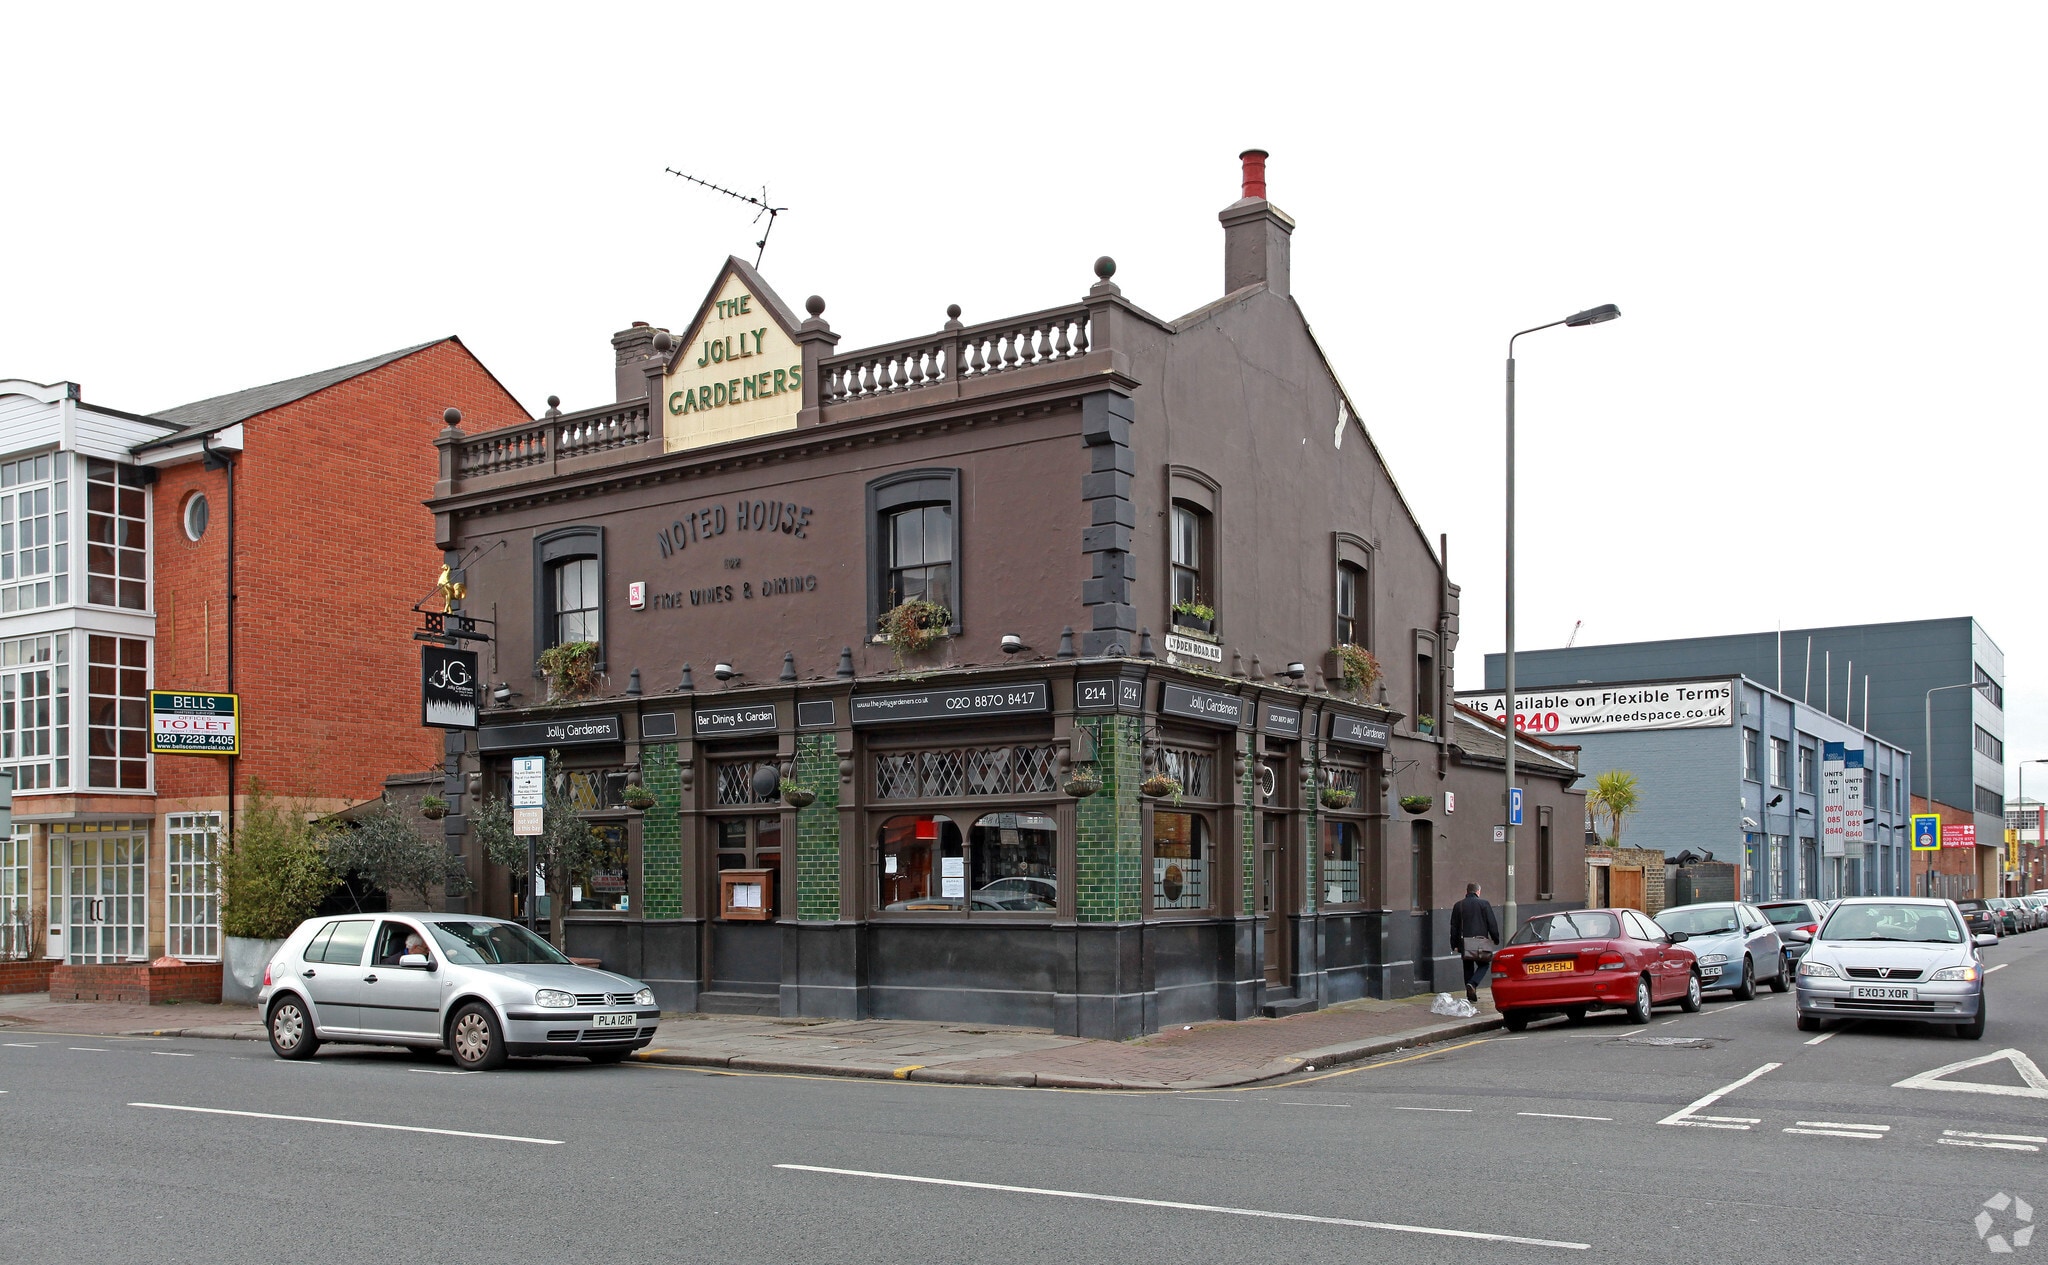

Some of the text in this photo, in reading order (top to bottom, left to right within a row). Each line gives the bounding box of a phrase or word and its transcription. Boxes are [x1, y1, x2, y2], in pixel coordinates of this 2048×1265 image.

[716, 294, 752, 319] THE
[698, 328, 767, 368] JOLLY
[668, 364, 802, 416] GARDENERS
[656, 500, 812, 558] NOTED HOUSE
[654, 575, 816, 609] FINE WINES & DINING
[1170, 638, 1192, 652] LYDDEN
[946, 697, 970, 709] 020
[974, 694, 1003, 708] 8870
[1008, 692, 1035, 705] 8417
[1085, 687, 1107, 700] 214
[1123, 687, 1137, 700] 214
[1494, 696, 1568, 711] Aailable
[1575, 697, 1596, 707] on
[1602, 690, 1669, 706] Flexible
[1676, 687, 1730, 701] Terms
[174, 696, 215, 709] BELLS
[1189, 695, 1238, 716] Jolly Gardeners
[698, 711, 772, 726] Bar Dining & Garden
[1570, 706, 1726, 724] www.needspace.co.uk
[158, 720, 231, 730] TO LET
[546, 723, 610, 739] Jolly Gardeners
[1351, 724, 1386, 740] Jolly Gardeners
[157, 734, 234, 745] 020 7228 4405
[1512, 792, 1520, 821] P
[1528, 962, 1573, 973] R942 EHJ
[1858, 988, 1885, 997] EX03
[598, 1016, 616, 1025] PLA
